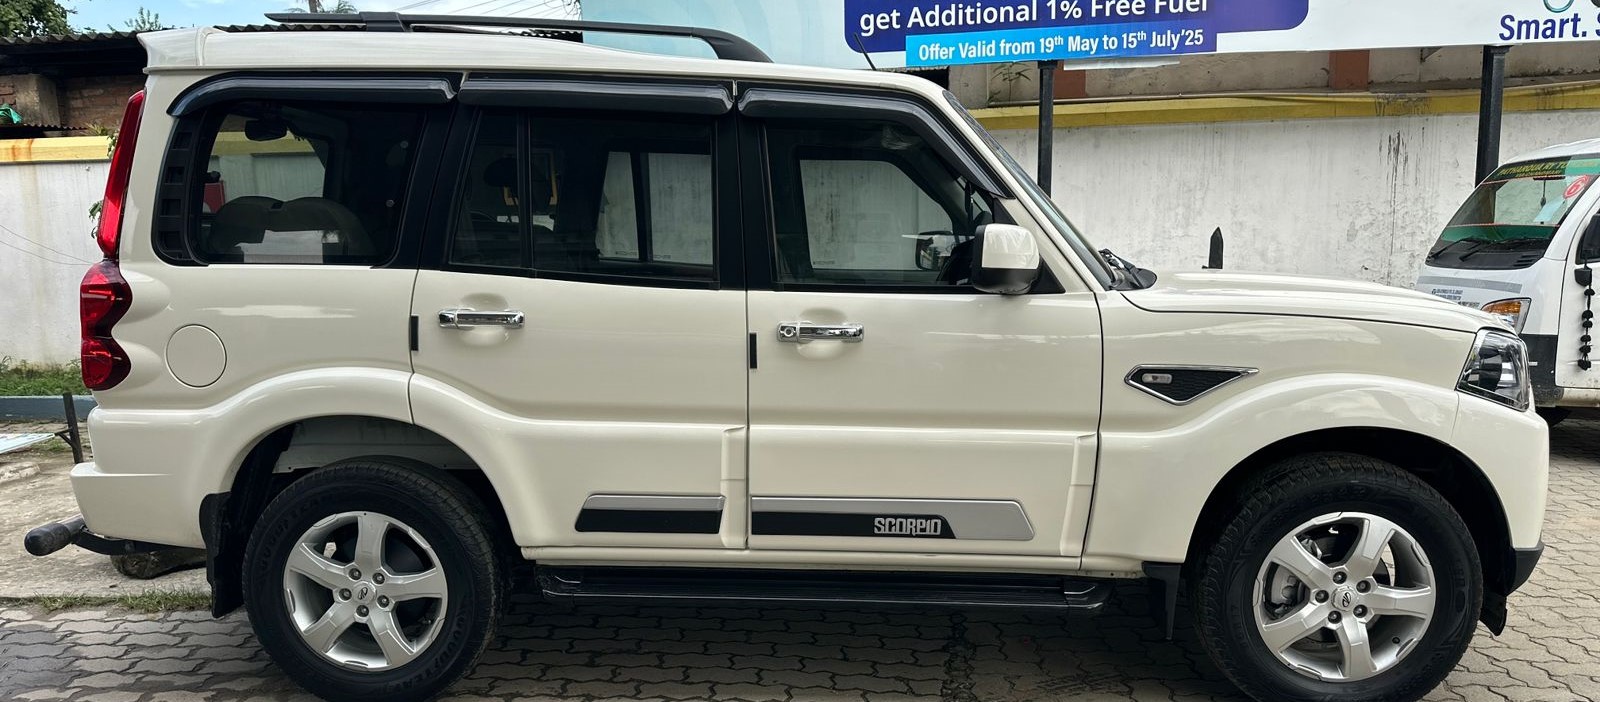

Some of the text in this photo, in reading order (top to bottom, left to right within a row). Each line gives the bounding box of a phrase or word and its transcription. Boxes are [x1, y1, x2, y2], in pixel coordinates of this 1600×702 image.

[860, 0, 1208, 37] get Additional 1% Free Fuel
[1498, 13, 1587, 41] Smart.
[918, 43, 956, 61] Offer
[958, 40, 996, 59] Valid
[999, 39, 1036, 56] from
[1039, 35, 1064, 54] 19th
[1067, 35, 1098, 55] May
[1102, 34, 1118, 50] to
[1121, 31, 1147, 49] 15th
[873, 517, 942, 537] SCORPIO
